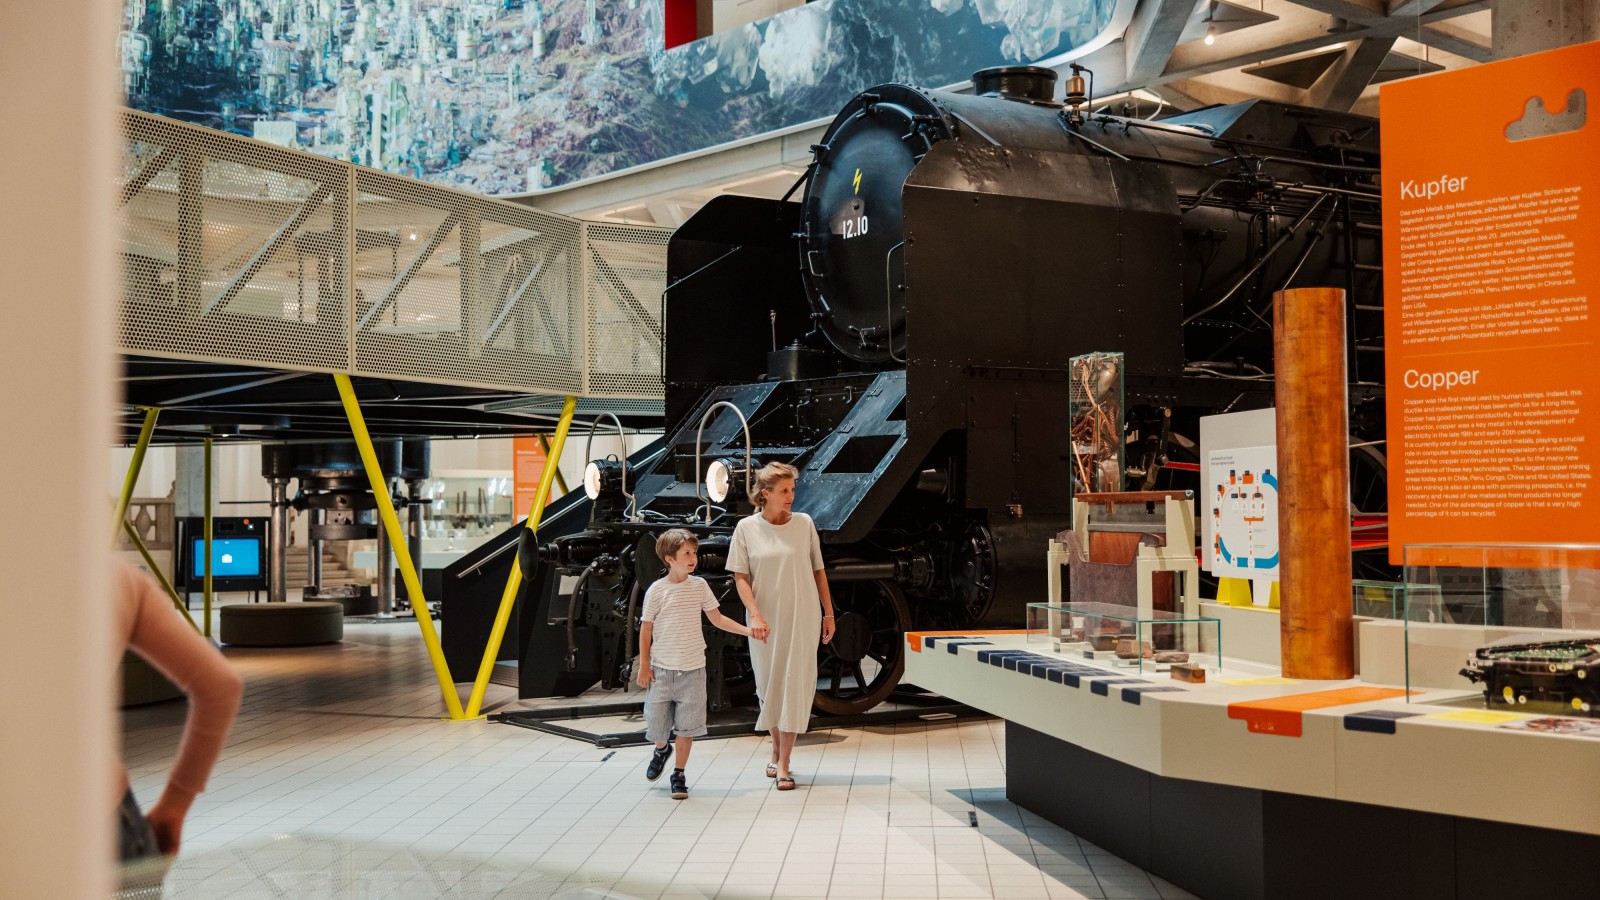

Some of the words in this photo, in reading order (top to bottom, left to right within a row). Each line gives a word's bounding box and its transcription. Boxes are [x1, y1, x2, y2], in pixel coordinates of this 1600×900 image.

[1400, 175, 1468, 200] Kupfer
[842, 215, 869, 240] 12.10
[1403, 368, 1480, 390] Copper
